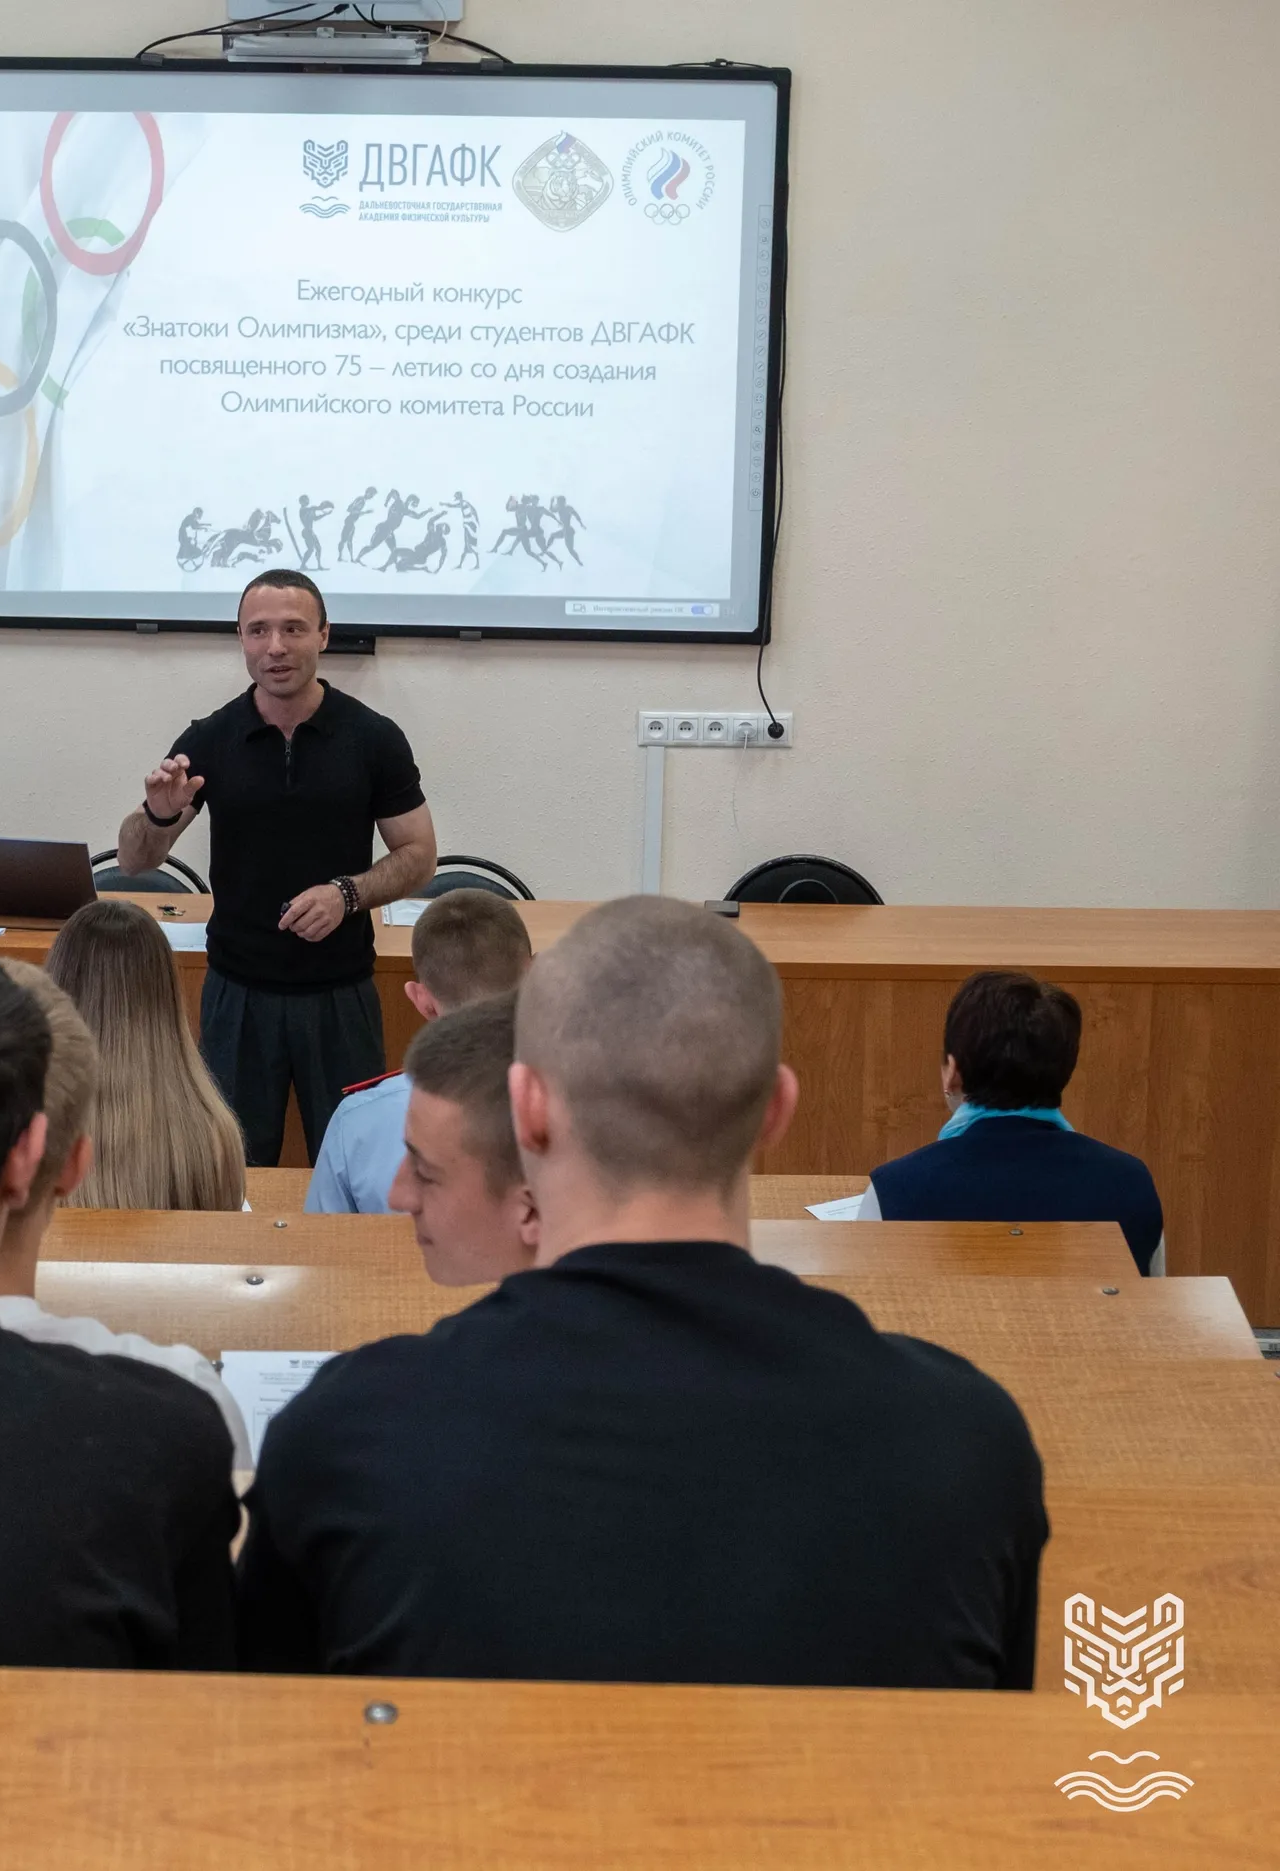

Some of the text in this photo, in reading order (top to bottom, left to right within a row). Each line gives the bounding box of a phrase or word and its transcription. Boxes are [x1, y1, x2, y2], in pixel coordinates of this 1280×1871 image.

[358, 142, 502, 192] ДВГАФК
[621, 130, 716, 211] ОЛИМПИЙСКИЙ КОМИТЕТ РОССИИ
[358, 200, 503, 212] ДАЛЬНЕВОСТОЧНАЯ ГОСУДАРСТВЕННАЯ
[358, 212, 490, 223] АКАДЕМИЯ ФИЗИЧЕСКОЙ КУЛЬТУРЫ
[297, 279, 523, 310] Ежегодный конкурс
[122, 315, 696, 347] «Знатоки Олимпизма», среди студентов ДВГАФК
[160, 358, 327, 378] посвященного
[334, 354, 362, 376] 75
[391, 361, 463, 378] летию
[470, 362, 497, 379] со
[504, 363, 545, 382] дня
[553, 363, 657, 383] создания
[221, 390, 595, 417] Олимпийского комитета России
